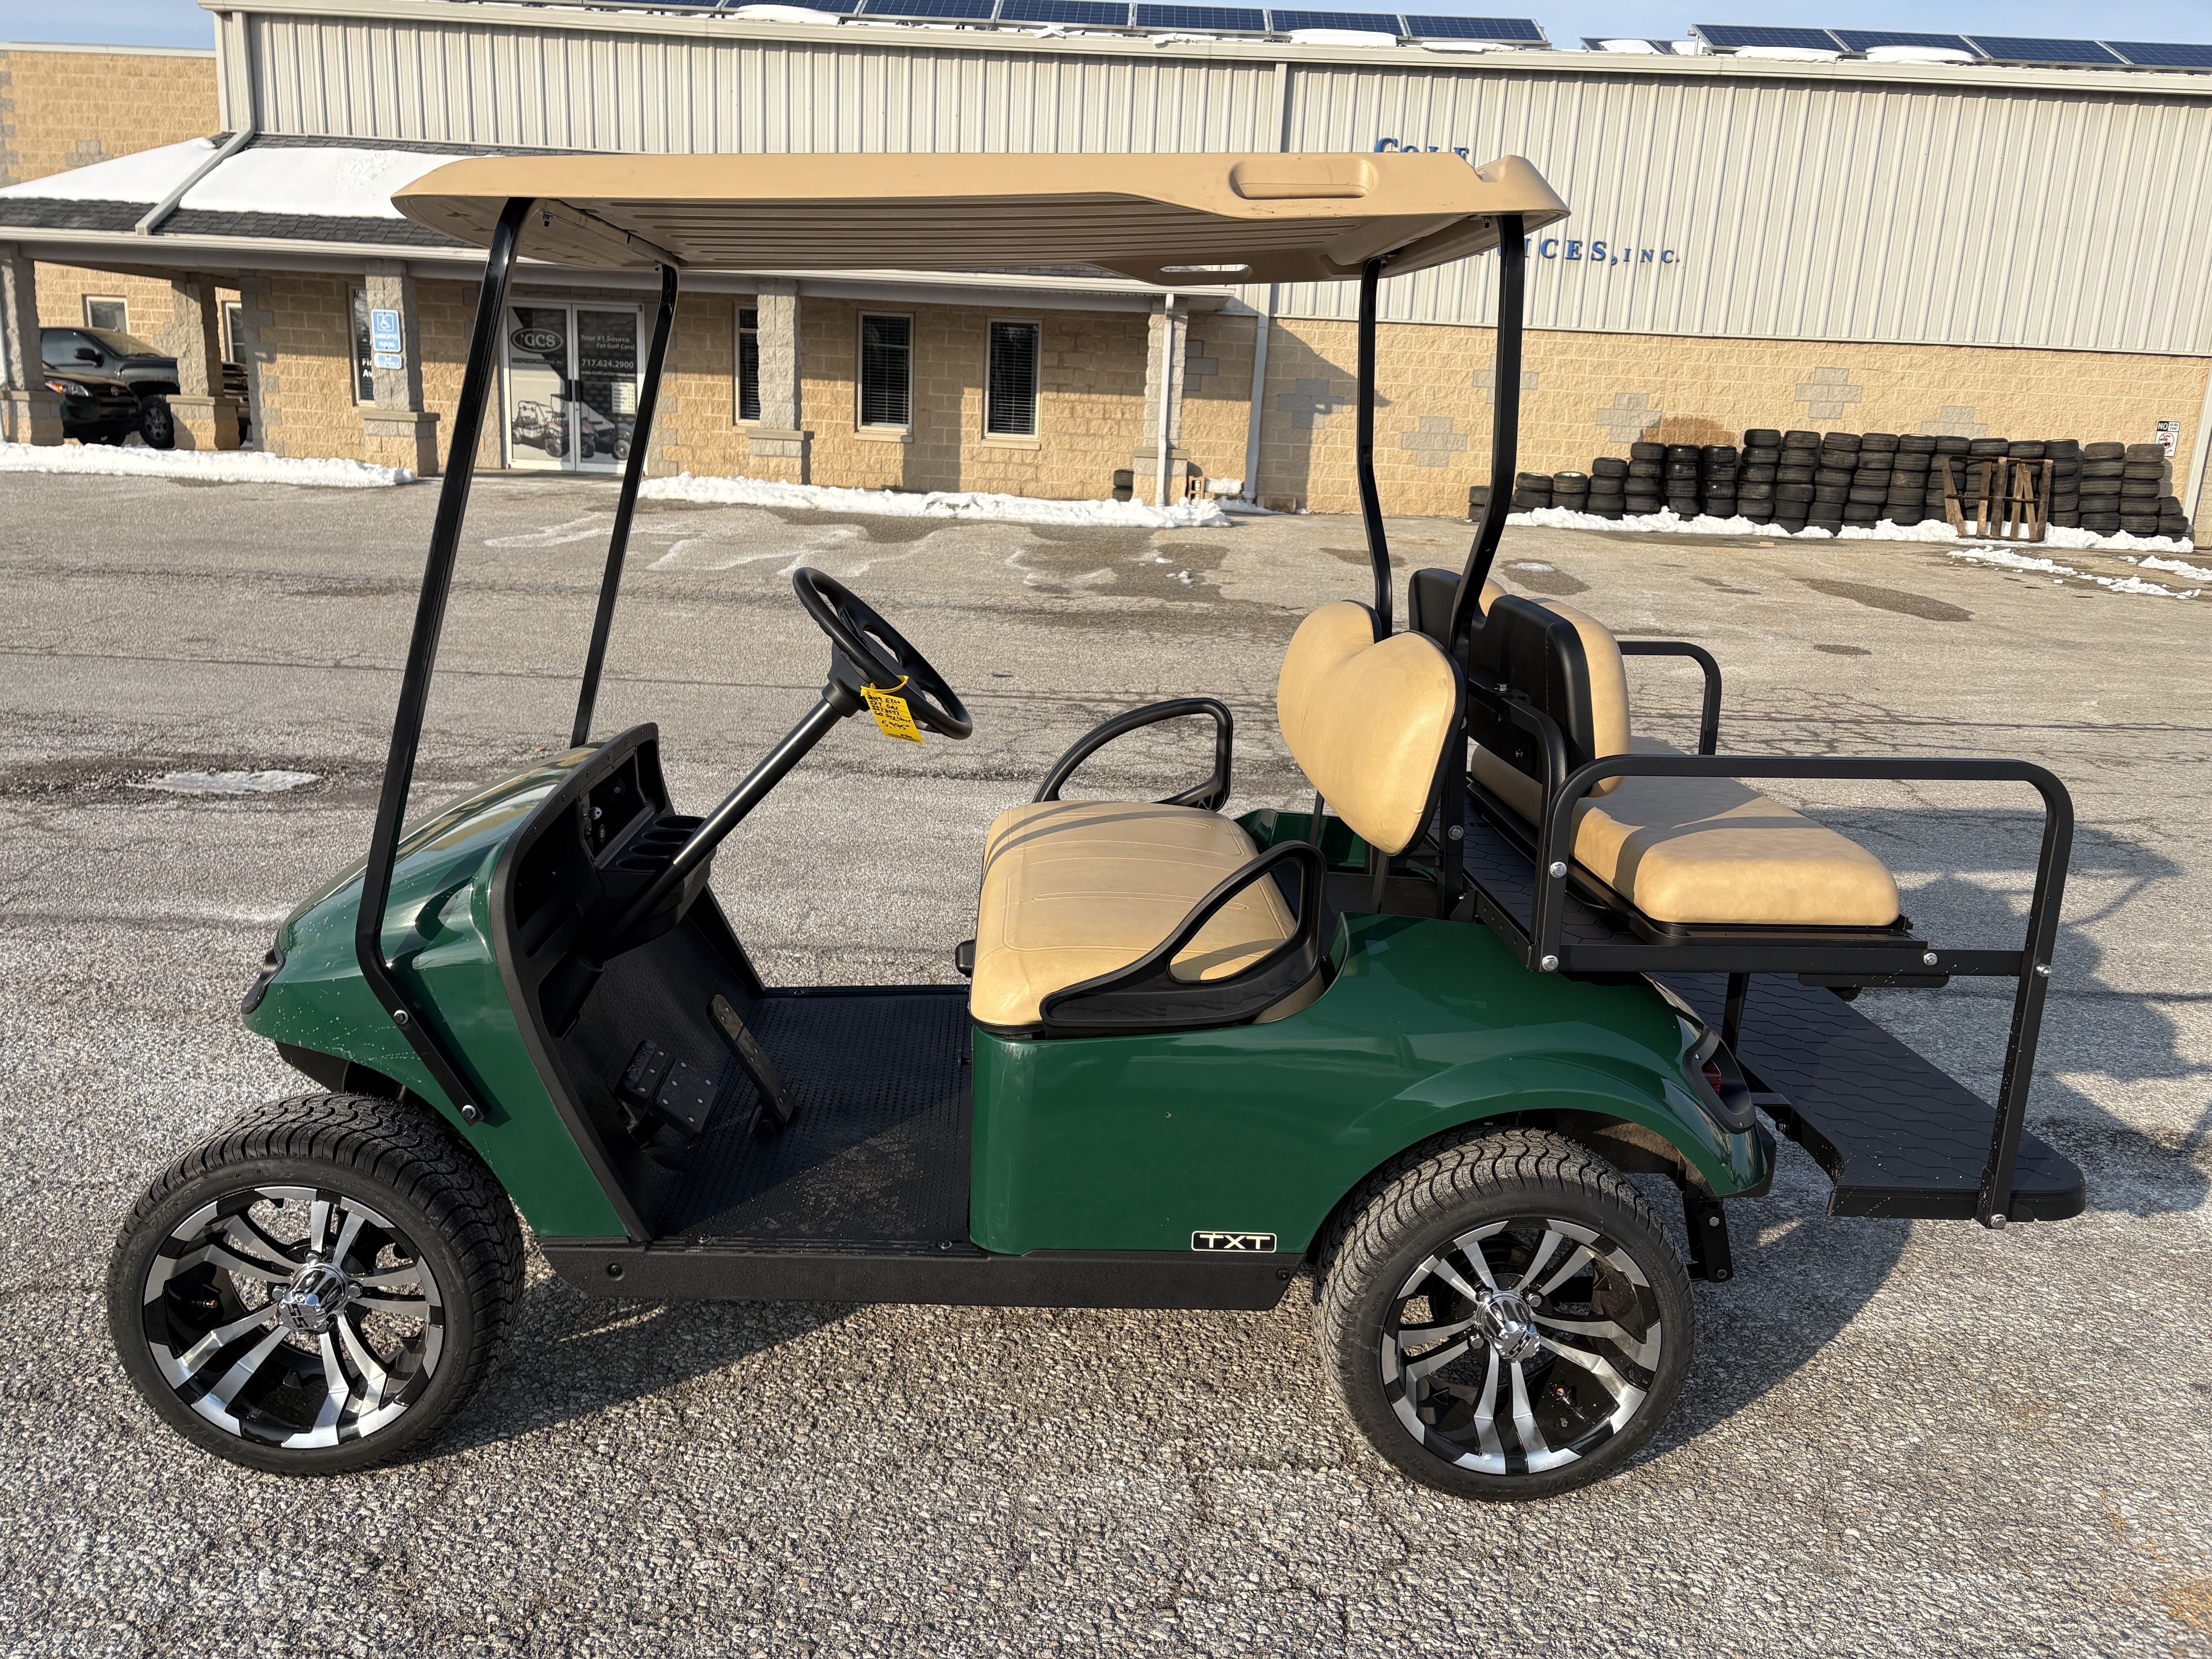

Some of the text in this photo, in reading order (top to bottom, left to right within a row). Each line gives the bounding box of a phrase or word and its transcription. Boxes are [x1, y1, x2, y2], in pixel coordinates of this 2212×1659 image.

[1623, 248, 1680, 263] INC.
[524, 333, 556, 347] GCS
[582, 358, 634, 369] 717.624.2900
[1199, 1233, 1270, 1249] TXT
